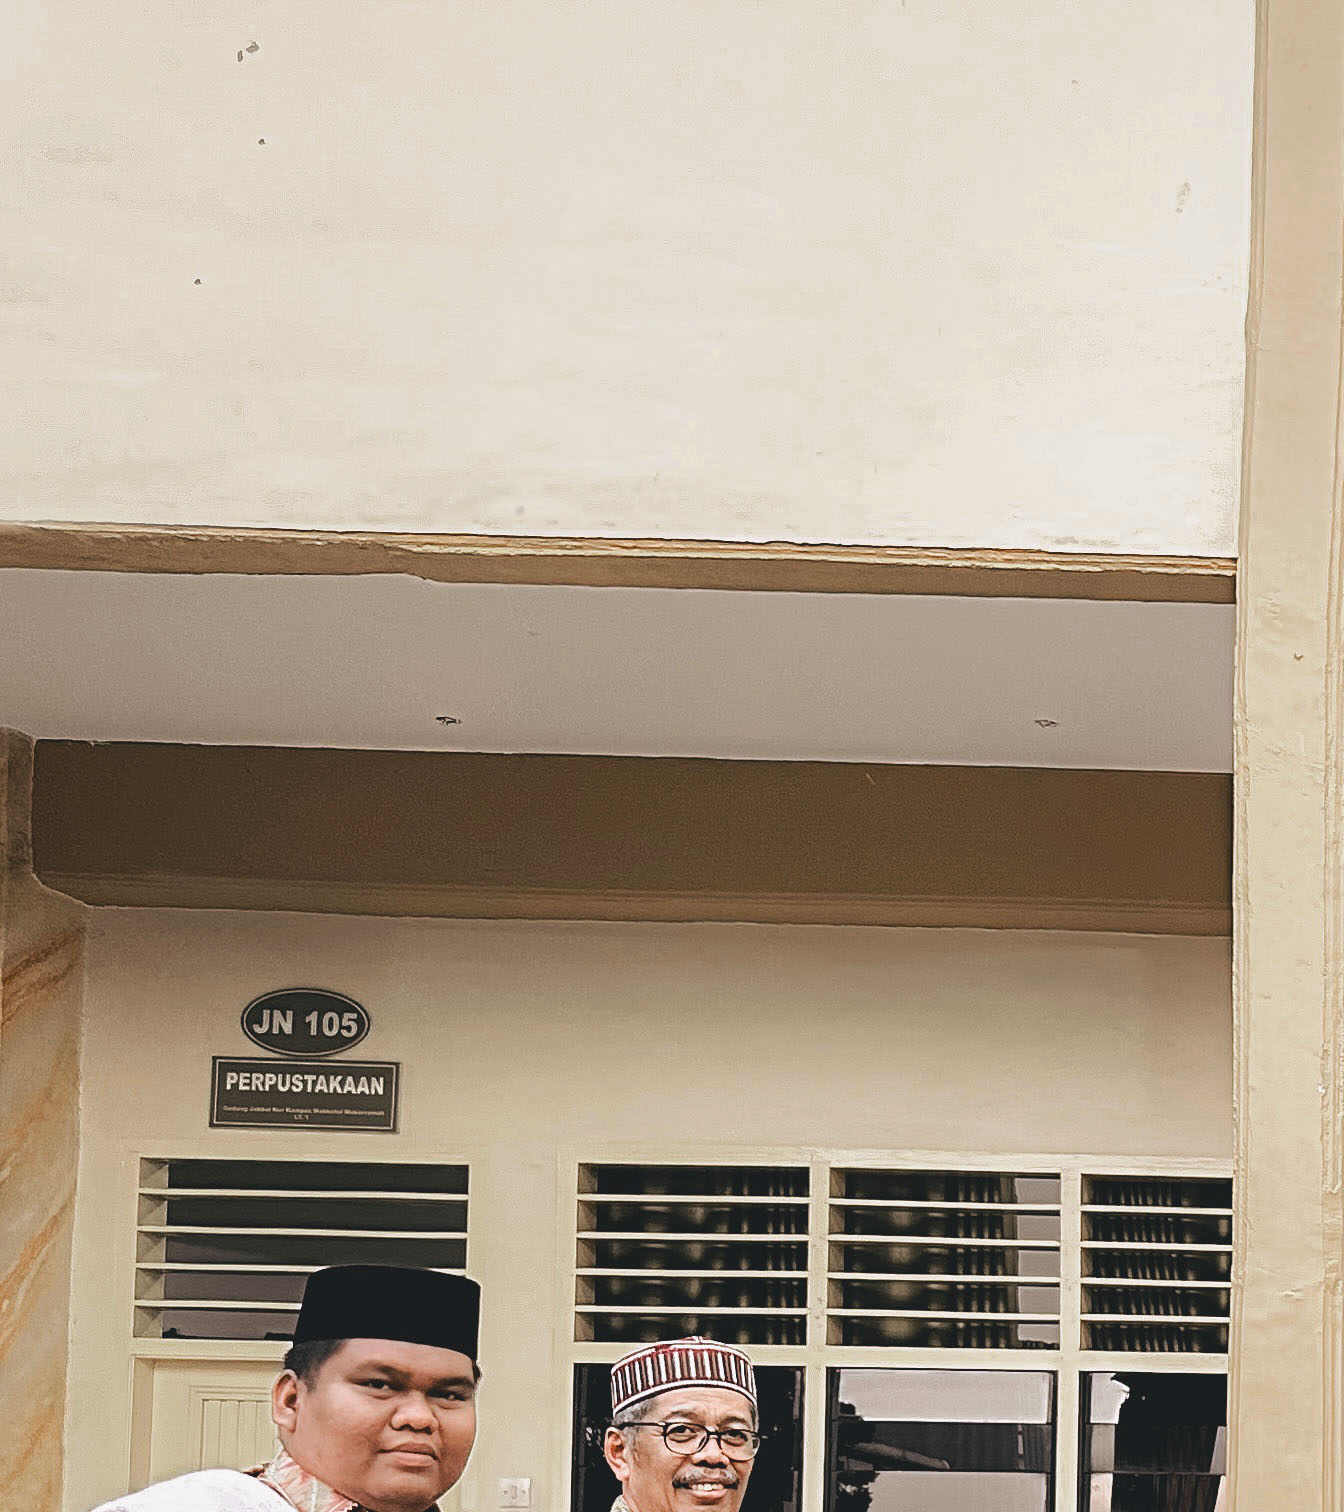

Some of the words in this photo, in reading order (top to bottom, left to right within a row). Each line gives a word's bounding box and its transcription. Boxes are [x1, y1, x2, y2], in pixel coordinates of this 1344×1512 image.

[253, 1009, 293, 1034] JN
[305, 1010, 358, 1037] 105
[226, 1072, 384, 1095] PERPUSTAKAAN
